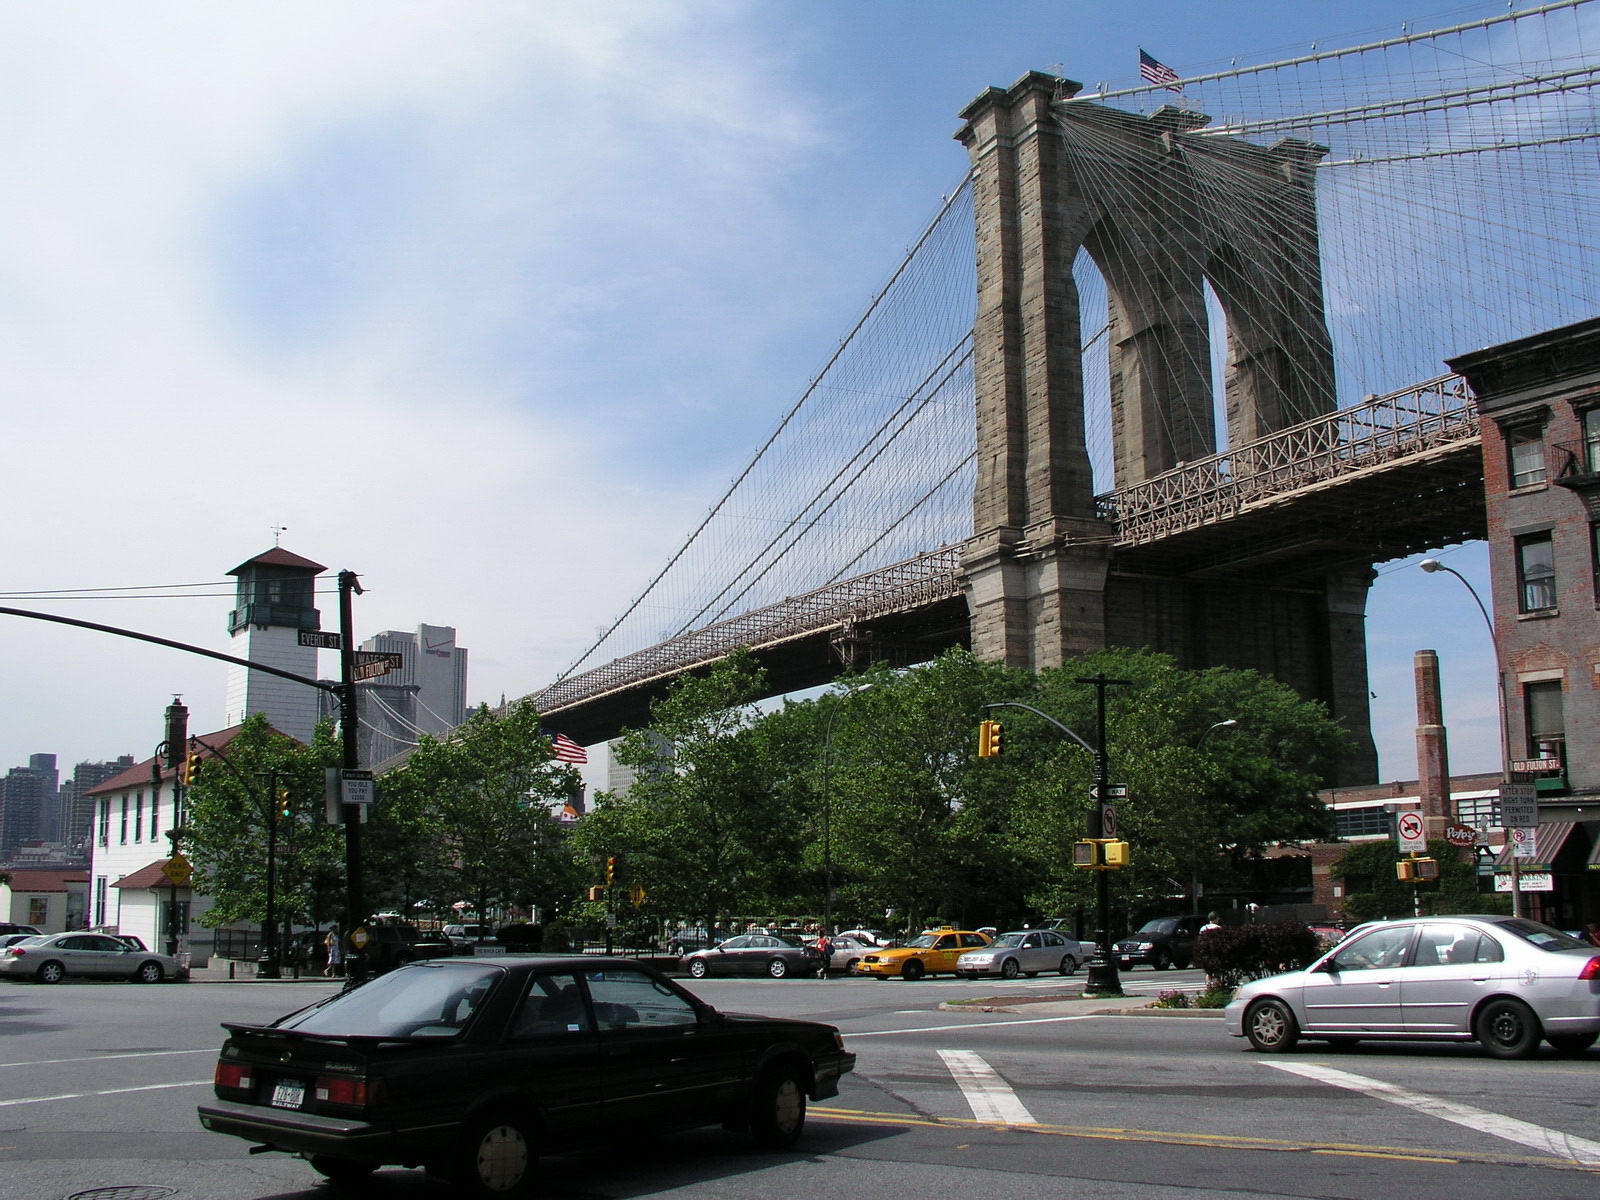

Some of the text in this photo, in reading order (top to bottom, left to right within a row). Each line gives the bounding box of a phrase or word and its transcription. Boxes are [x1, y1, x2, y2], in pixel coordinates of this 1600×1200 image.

[302, 633, 337, 648] EVERIT ST
[390, 656, 399, 668] ST
[354, 665, 365, 681] OLD
[366, 661, 385, 677] FULTON
[1513, 759, 1556, 771] OLD FULTON ST
[1502, 787, 1533, 795] AFTER STOP
[1504, 806, 1534, 814] PERMITTED
[1519, 815, 1530, 823] RED
